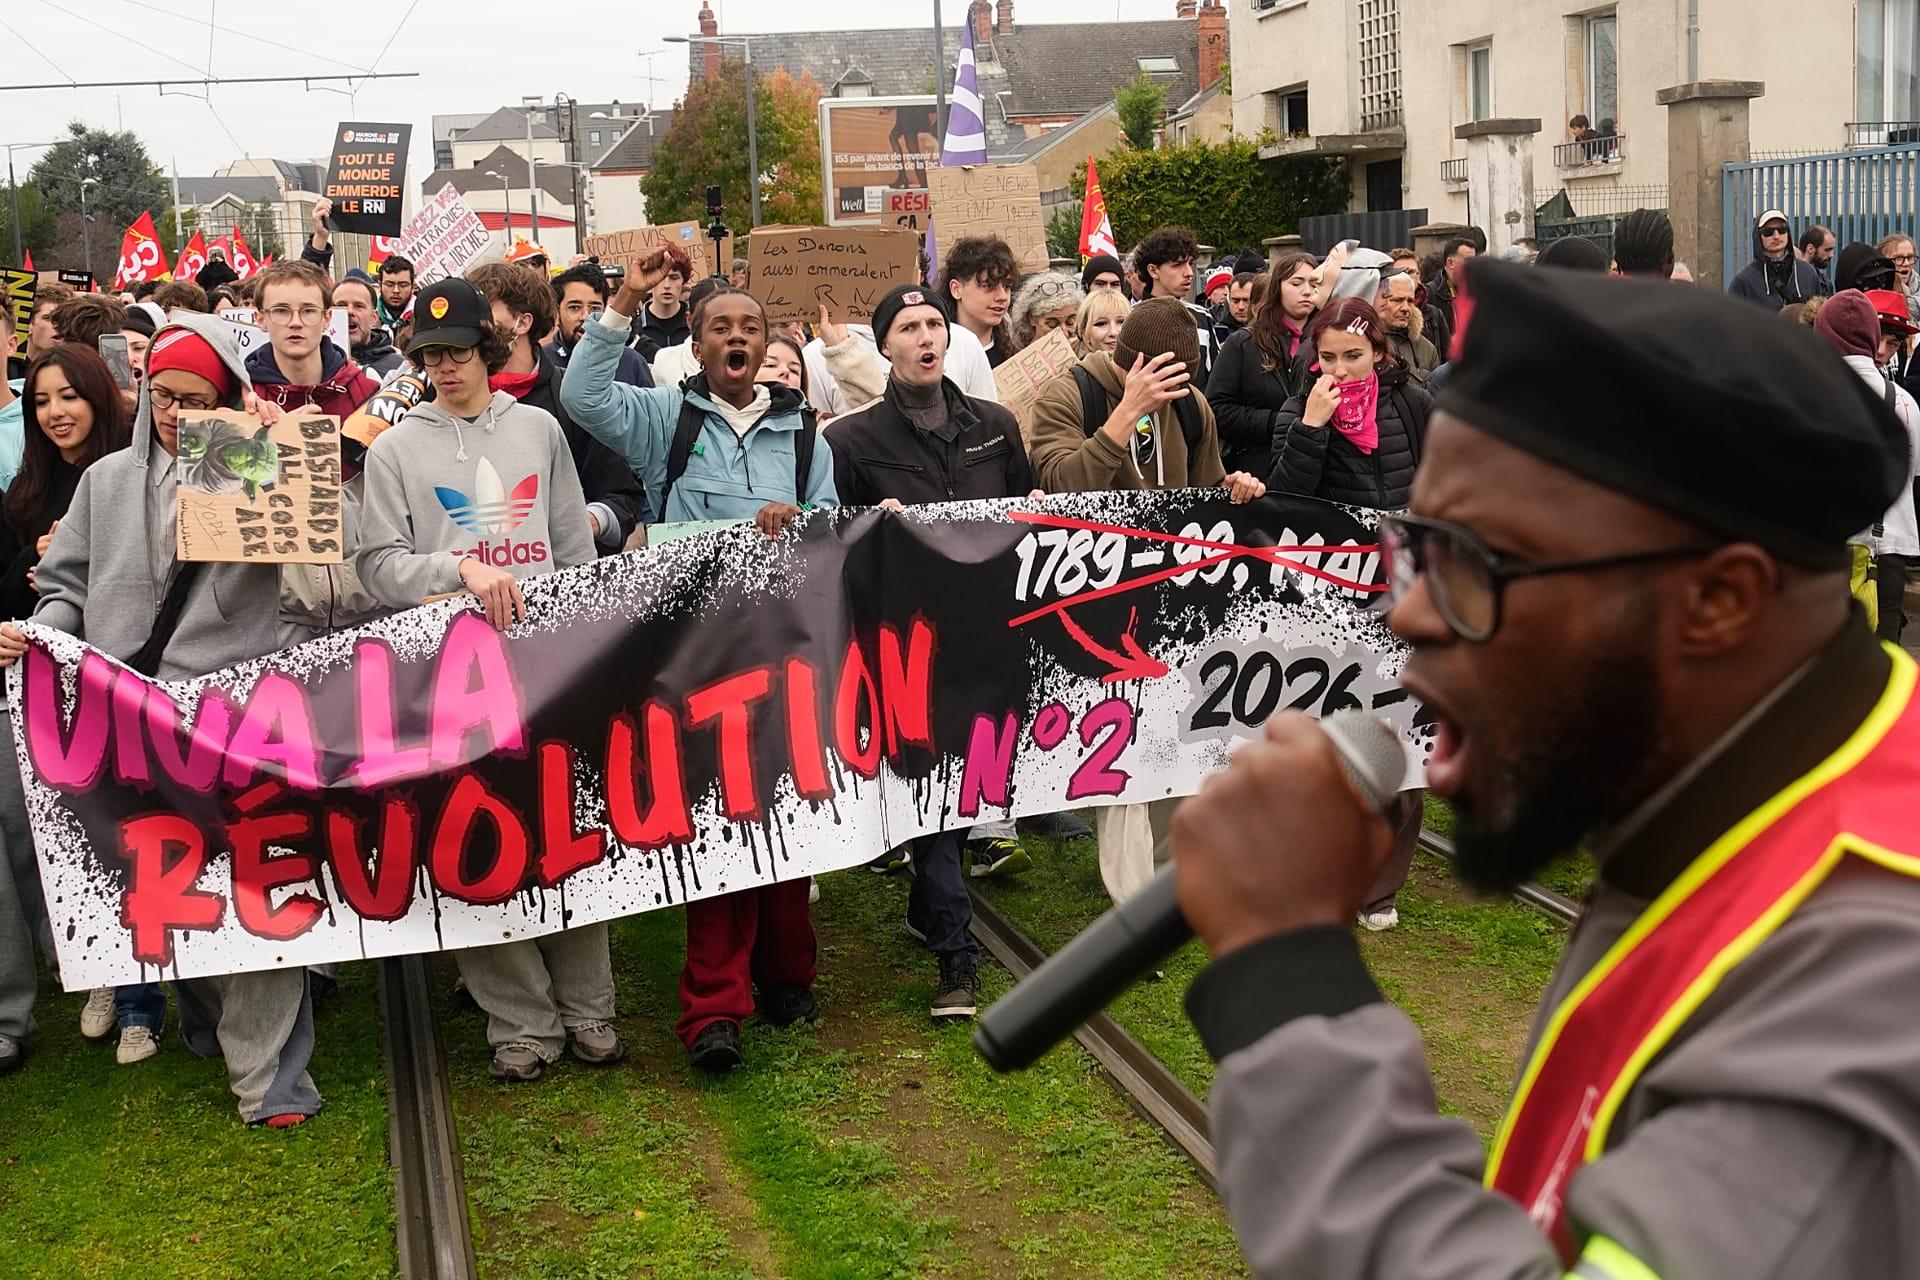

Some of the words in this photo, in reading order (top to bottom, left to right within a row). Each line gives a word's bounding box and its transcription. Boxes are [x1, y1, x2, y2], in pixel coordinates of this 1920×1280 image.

[338, 153, 375, 166] TOUT
[377, 152, 395, 165] LE
[850, 155, 865, 164] pas
[866, 153, 889, 162] avant
[891, 152, 902, 161] de
[903, 151, 931, 160] revenir
[864, 163, 877, 171] les
[878, 162, 903, 171] bancs
[904, 161, 916, 170] de
[917, 160, 924, 170] la
[339, 168, 391, 181] MONDE
[326, 184, 400, 198] EMMERDE
[891, 191, 930, 212] RÉSI
[342, 200, 359, 213] LE
[363, 199, 386, 214] RN
[841, 199, 863, 212] Well
[391, 204, 440, 253] RANGEZ
[407, 202, 466, 261] MATRAQUES
[641, 228, 666, 248] VOS
[763, 239, 788, 256] Les
[762, 259, 799, 277] aussi
[766, 284, 792, 306] Le
[814, 284, 839, 307] R
[277, 442, 303, 485] ALL
[298, 418, 340, 554] BASTARDS
[193, 500, 228, 540] YODA
[268, 493, 299, 555] COPS
[235, 507, 270, 557] ARE
[451, 538, 547, 567] didas
[21, 639, 325, 794] VIVA
[351, 608, 530, 790] LA
[119, 610, 938, 967] RÉVOLUTION
